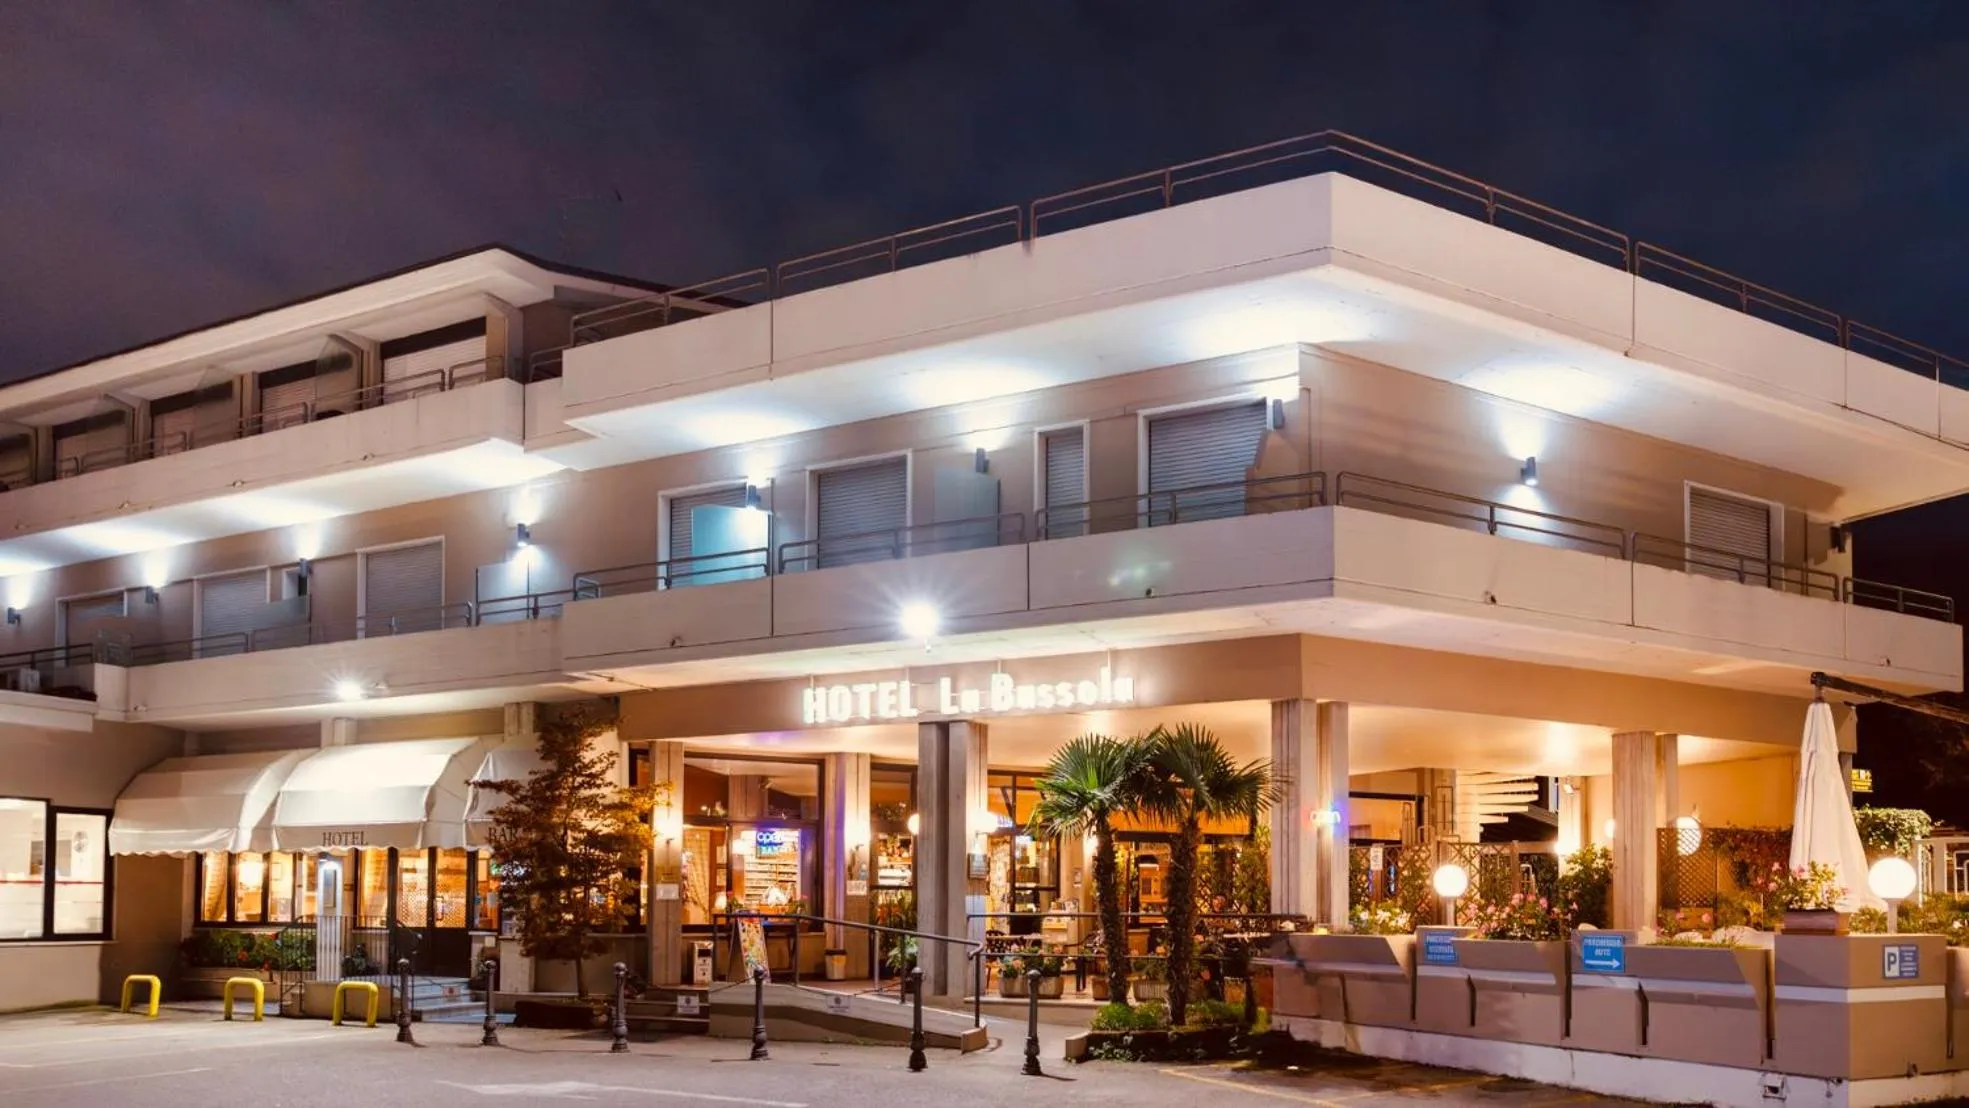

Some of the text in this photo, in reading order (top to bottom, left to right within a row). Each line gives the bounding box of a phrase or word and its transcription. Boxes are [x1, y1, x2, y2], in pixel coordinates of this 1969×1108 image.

[803, 665, 1135, 724] HOTEL La Bussola
[322, 831, 369, 847] HOTEL
[1887, 952, 1898, 971] P
